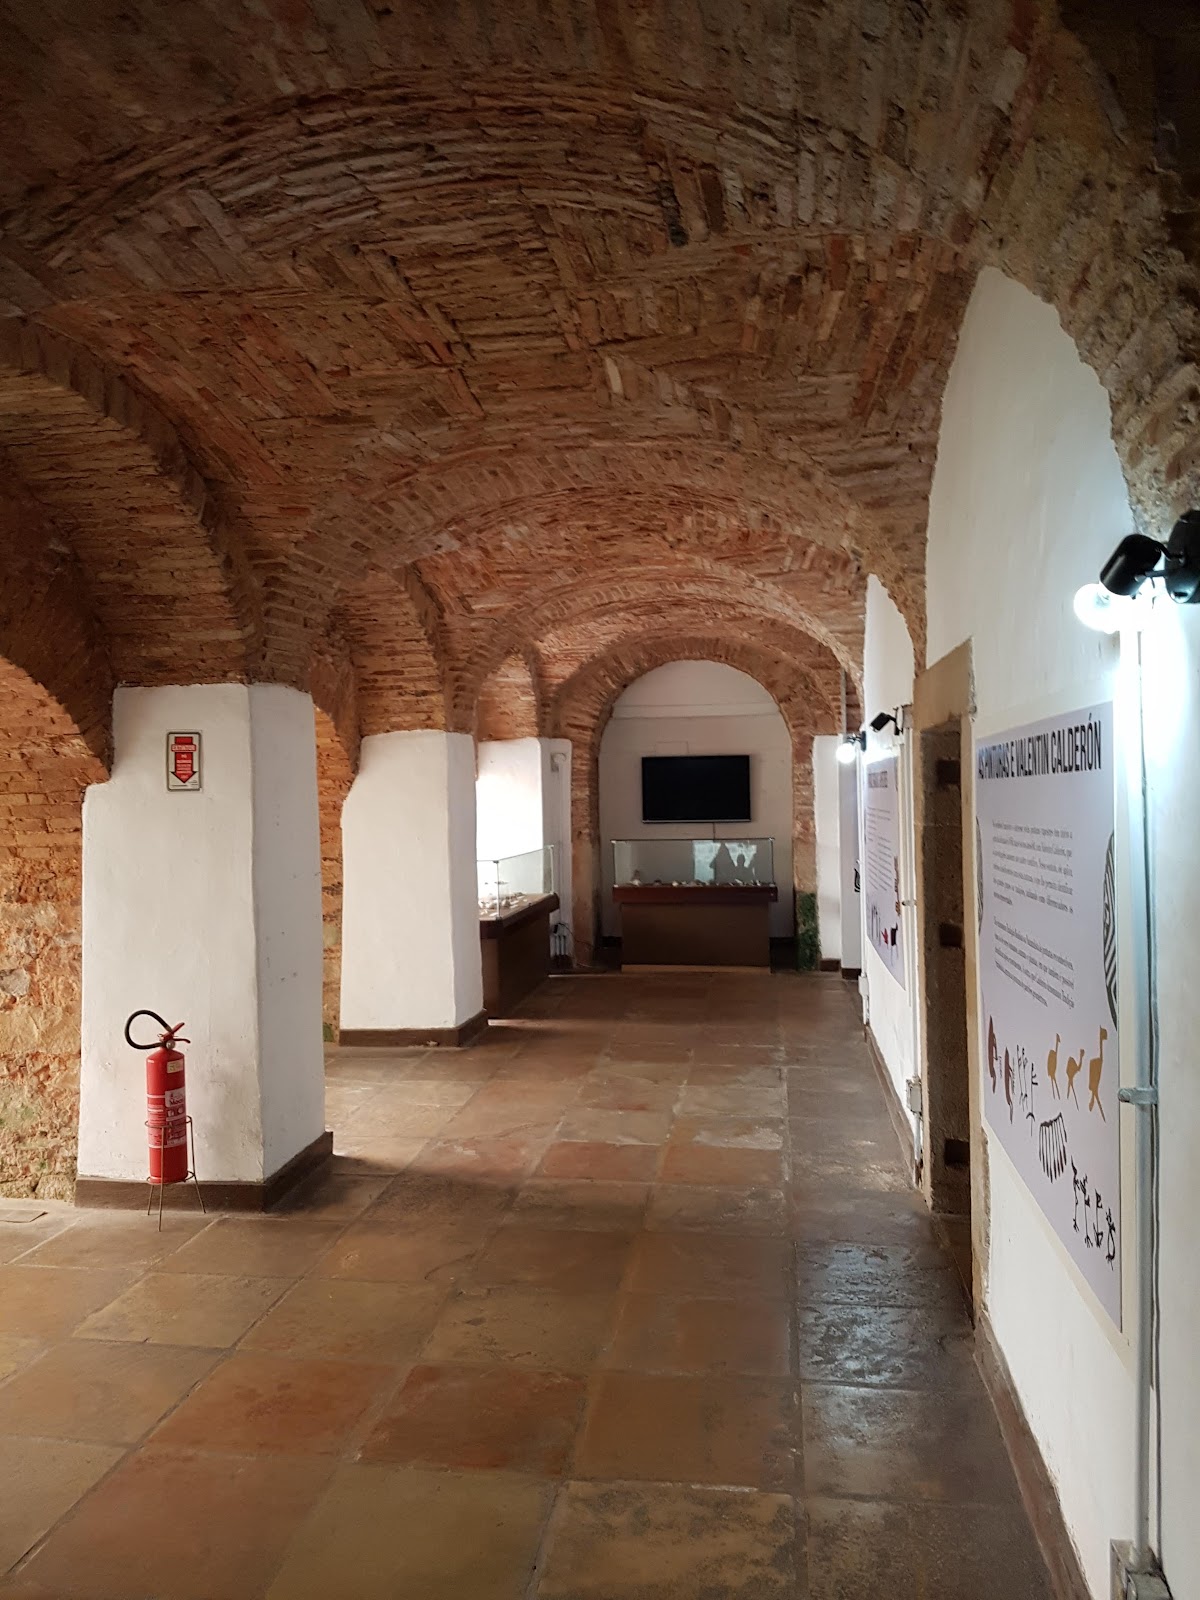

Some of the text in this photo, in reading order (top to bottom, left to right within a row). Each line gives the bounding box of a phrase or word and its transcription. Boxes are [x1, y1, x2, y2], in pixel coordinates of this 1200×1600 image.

[1011, 741, 1015, 778] E
[1015, 733, 1049, 777] VALENTIN
[1051, 712, 1102, 774] CALDERÓN
